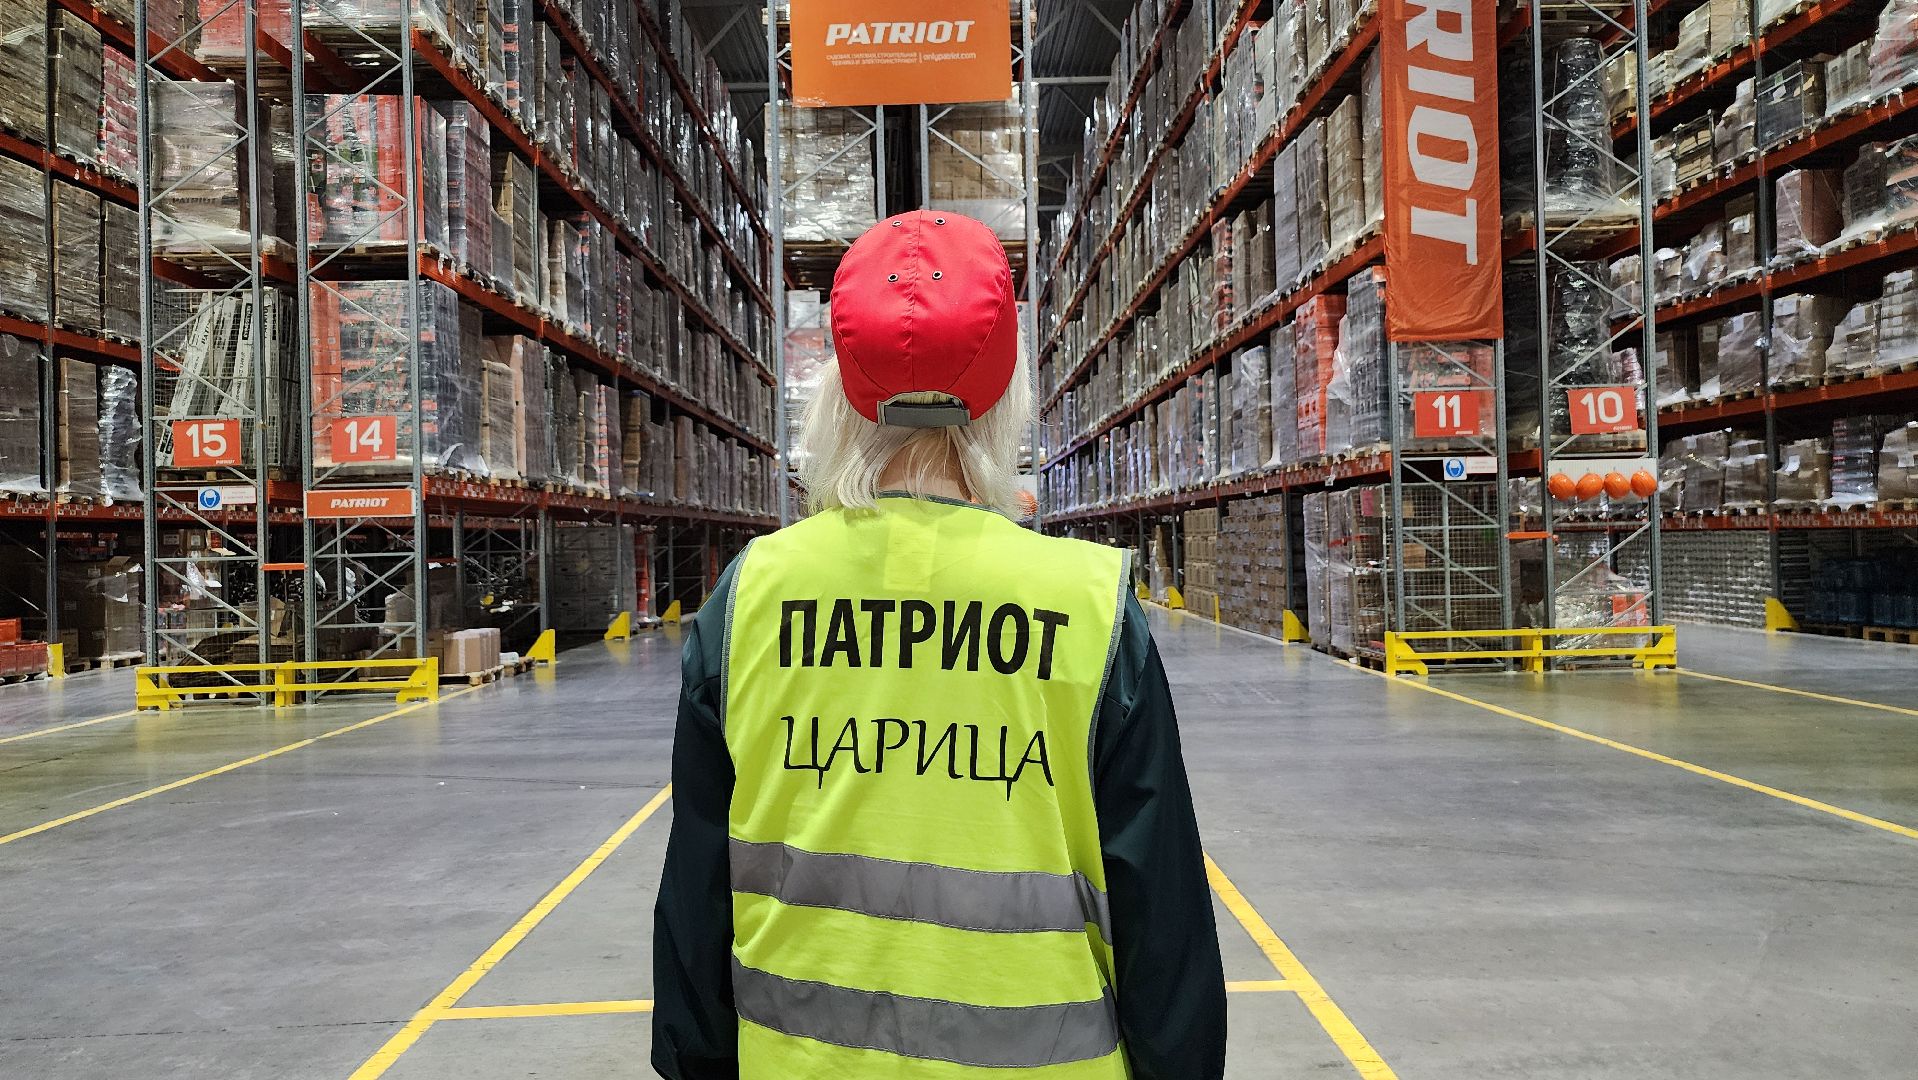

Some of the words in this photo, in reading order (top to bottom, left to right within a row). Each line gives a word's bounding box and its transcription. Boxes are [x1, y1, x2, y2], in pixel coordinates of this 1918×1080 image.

[825, 20, 975, 46] PATRIOT
[1431, 395, 1460, 428] 11
[1580, 391, 1624, 424] 10
[186, 423, 227, 458] 15
[344, 420, 383, 453] 14
[330, 497, 390, 509] PATRIOT
[779, 598, 1070, 680] ПАТРИОТ
[780, 715, 1055, 802] ЦАРИЦА
